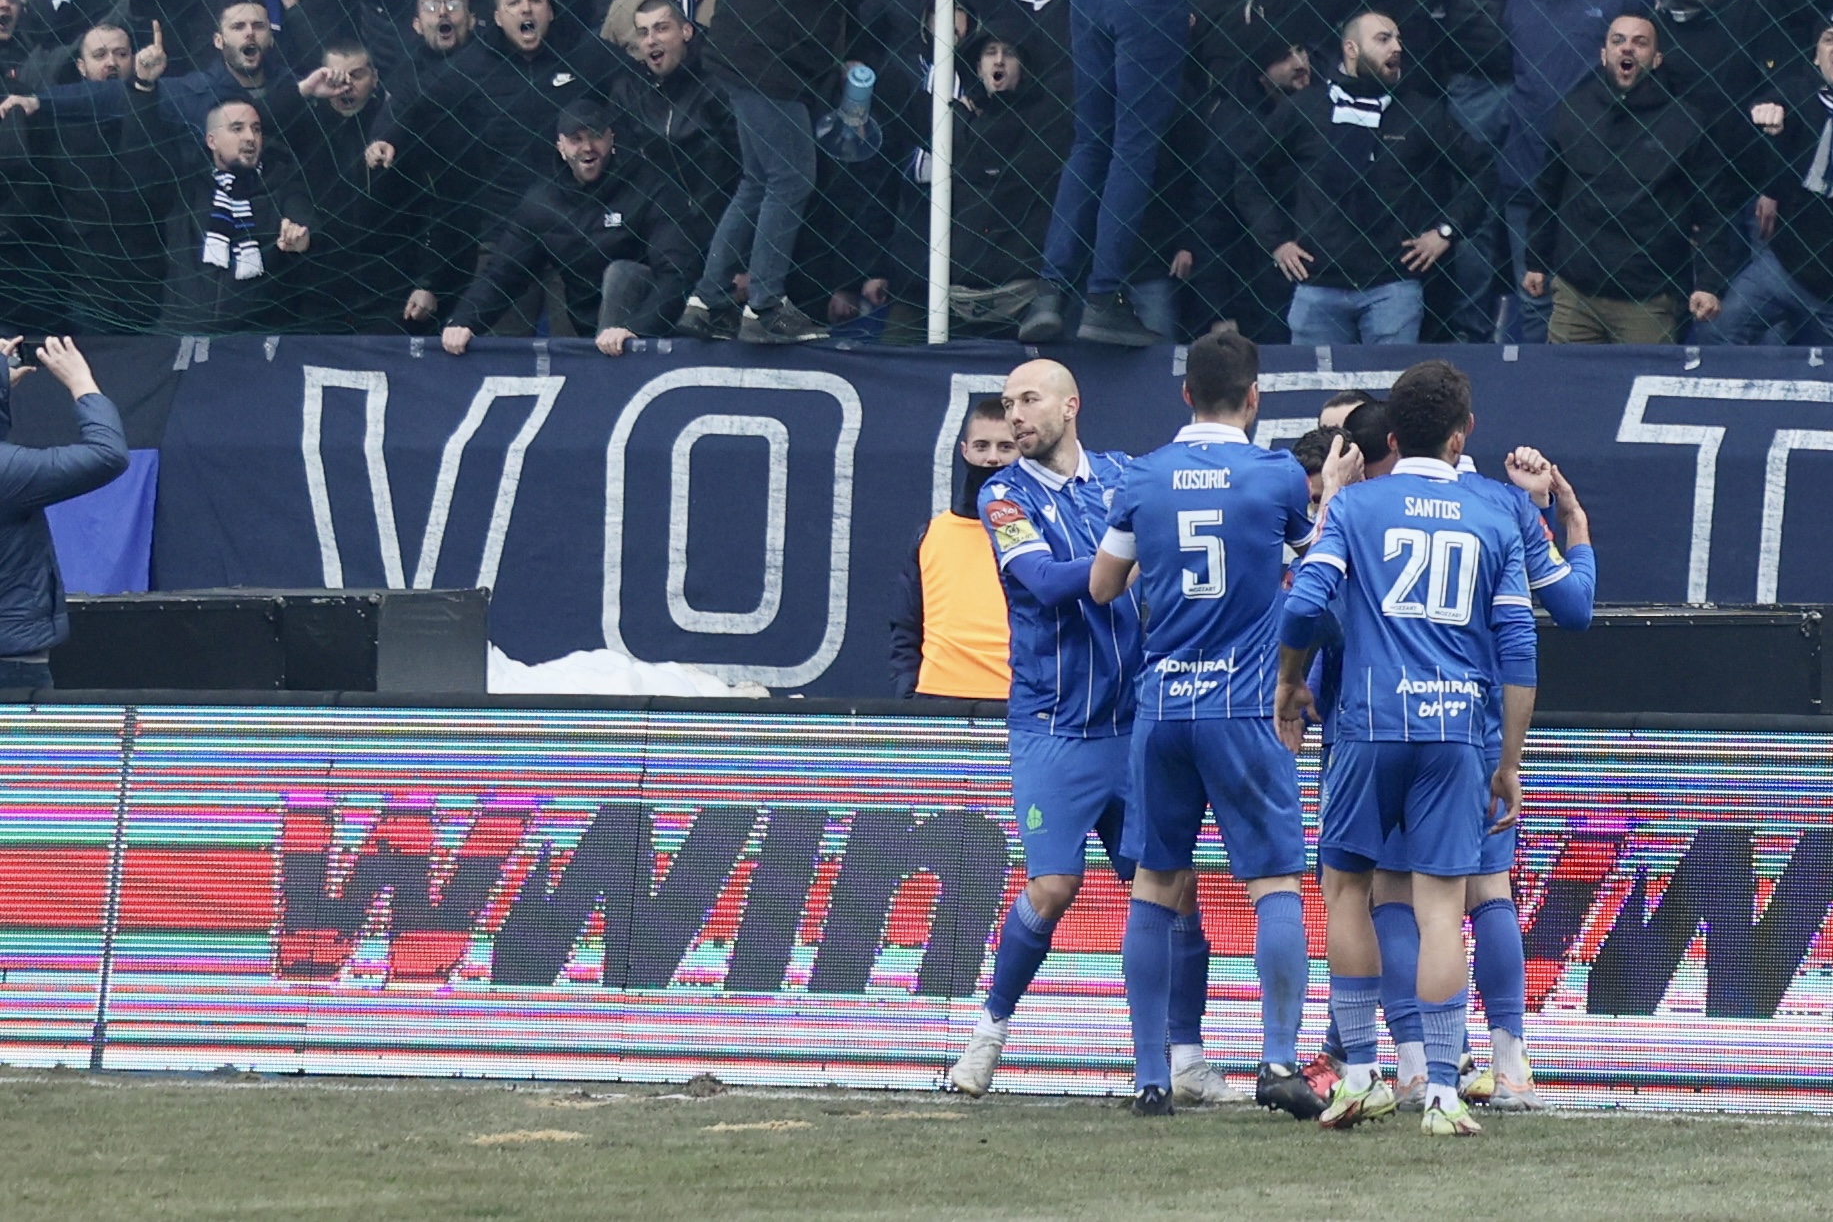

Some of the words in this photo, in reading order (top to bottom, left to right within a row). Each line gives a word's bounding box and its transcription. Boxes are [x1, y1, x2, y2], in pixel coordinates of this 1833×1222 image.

[1172, 466, 1231, 490] KOSORIĆ
[1404, 496, 1461, 520] SANTOS
[1177, 509, 1226, 599] 5
[1381, 527, 1481, 626] 20
[1154, 657, 1240, 674] ADMIRAL
[1396, 678, 1482, 698] ADMIRAL
